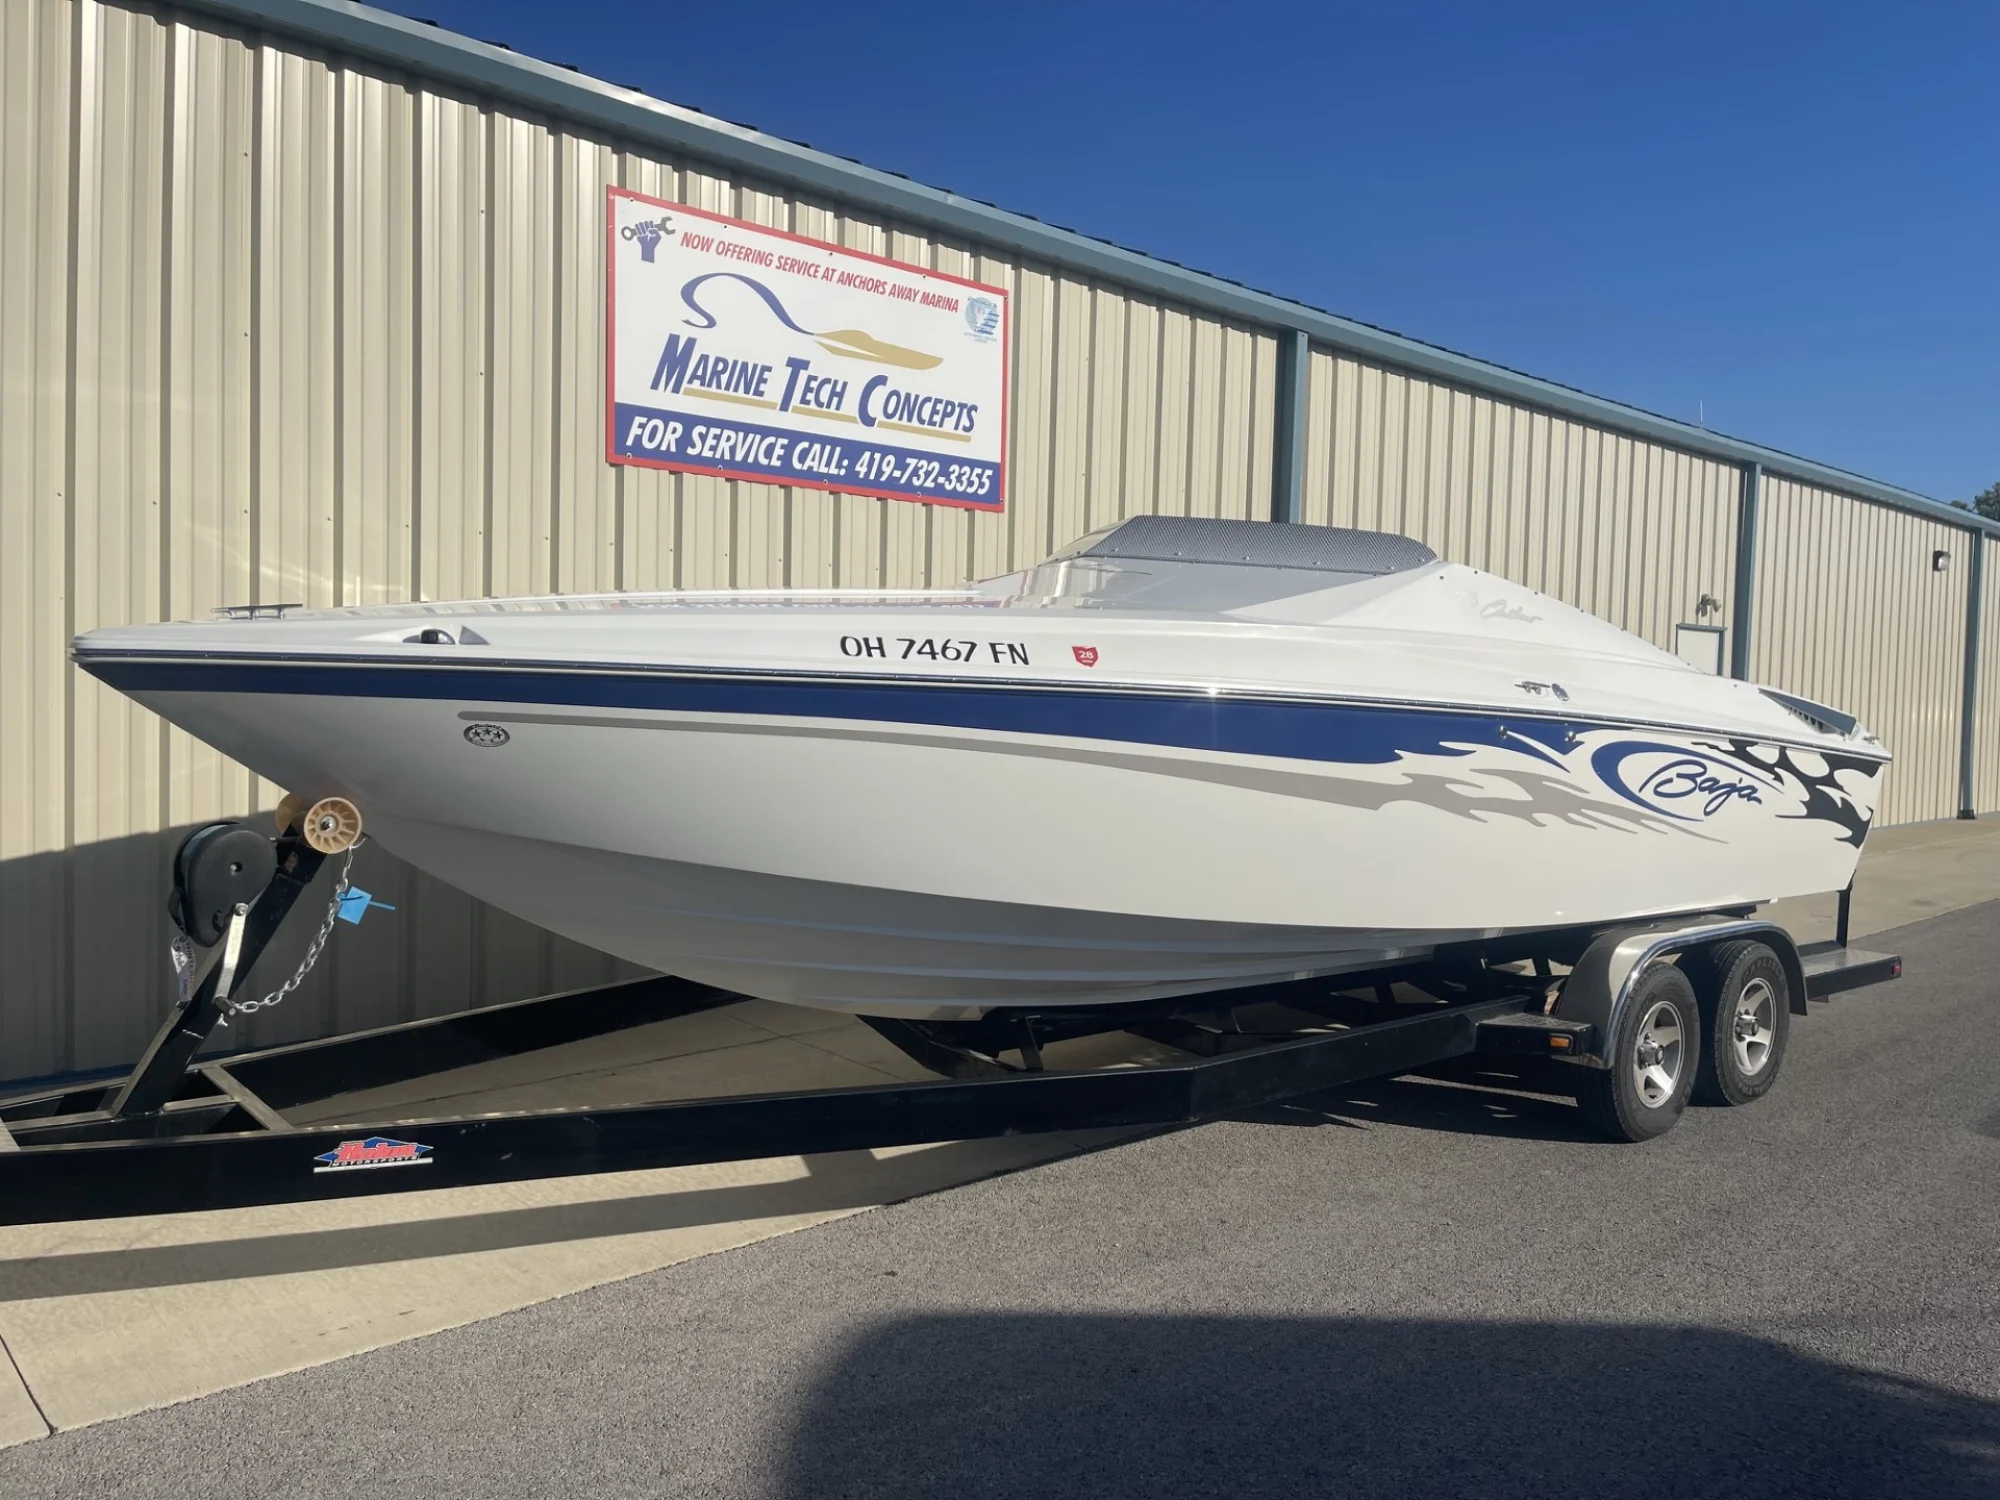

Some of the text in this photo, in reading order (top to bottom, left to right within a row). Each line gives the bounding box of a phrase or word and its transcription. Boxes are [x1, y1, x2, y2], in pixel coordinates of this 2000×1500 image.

[680, 231, 713, 252] NOW
[716, 241, 773, 267] OFFERING
[775, 256, 821, 279] SERVICE
[821, 268, 838, 282] AT
[836, 273, 887, 295] ANCHORS
[888, 283, 920, 304] AWAY
[919, 292, 959, 313] MARINA
[650, 333, 978, 433] MARINE TECH CONCEPTS
[626, 416, 993, 495] FOR SERVICE CALL: 419-732-3355
[840, 636, 1030, 666] OH 7467 FN
[1639, 759, 1762, 817] Baja
